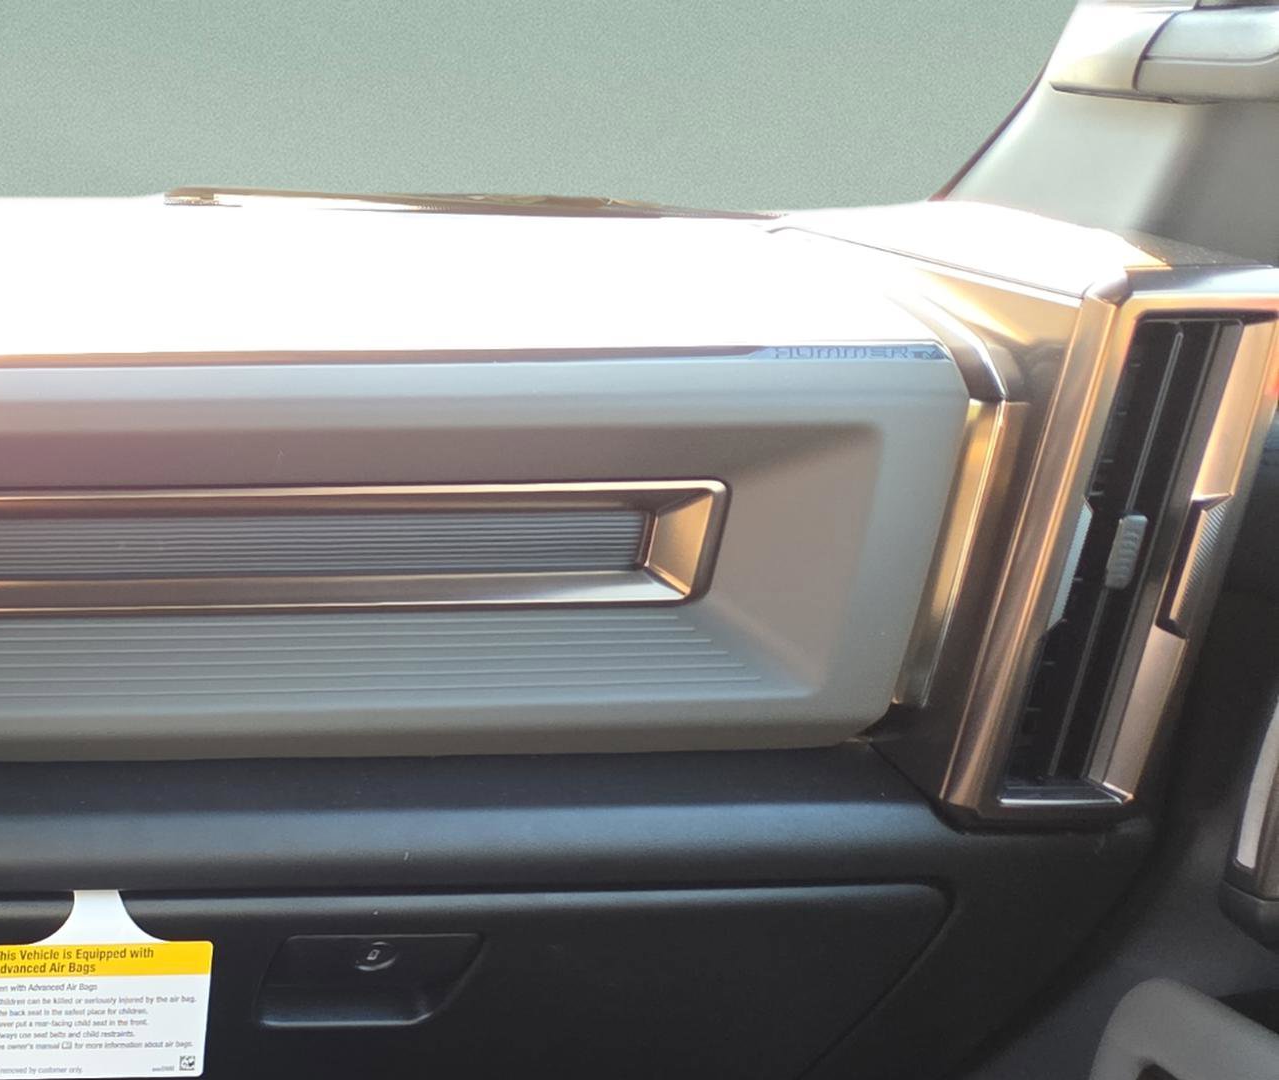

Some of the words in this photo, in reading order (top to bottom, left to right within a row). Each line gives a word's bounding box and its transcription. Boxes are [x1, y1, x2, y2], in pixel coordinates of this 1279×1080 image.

[20, 949, 59, 960] Vehicle
[63, 949, 72, 959] is
[76, 948, 126, 961] Equipped
[130, 947, 154, 958] with
[49, 963, 67, 973] Air
[68, 963, 96, 975] Bags
[10, 984, 26, 992] with
[28, 984, 64, 992] Advanced
[79, 984, 97, 992] Bags
